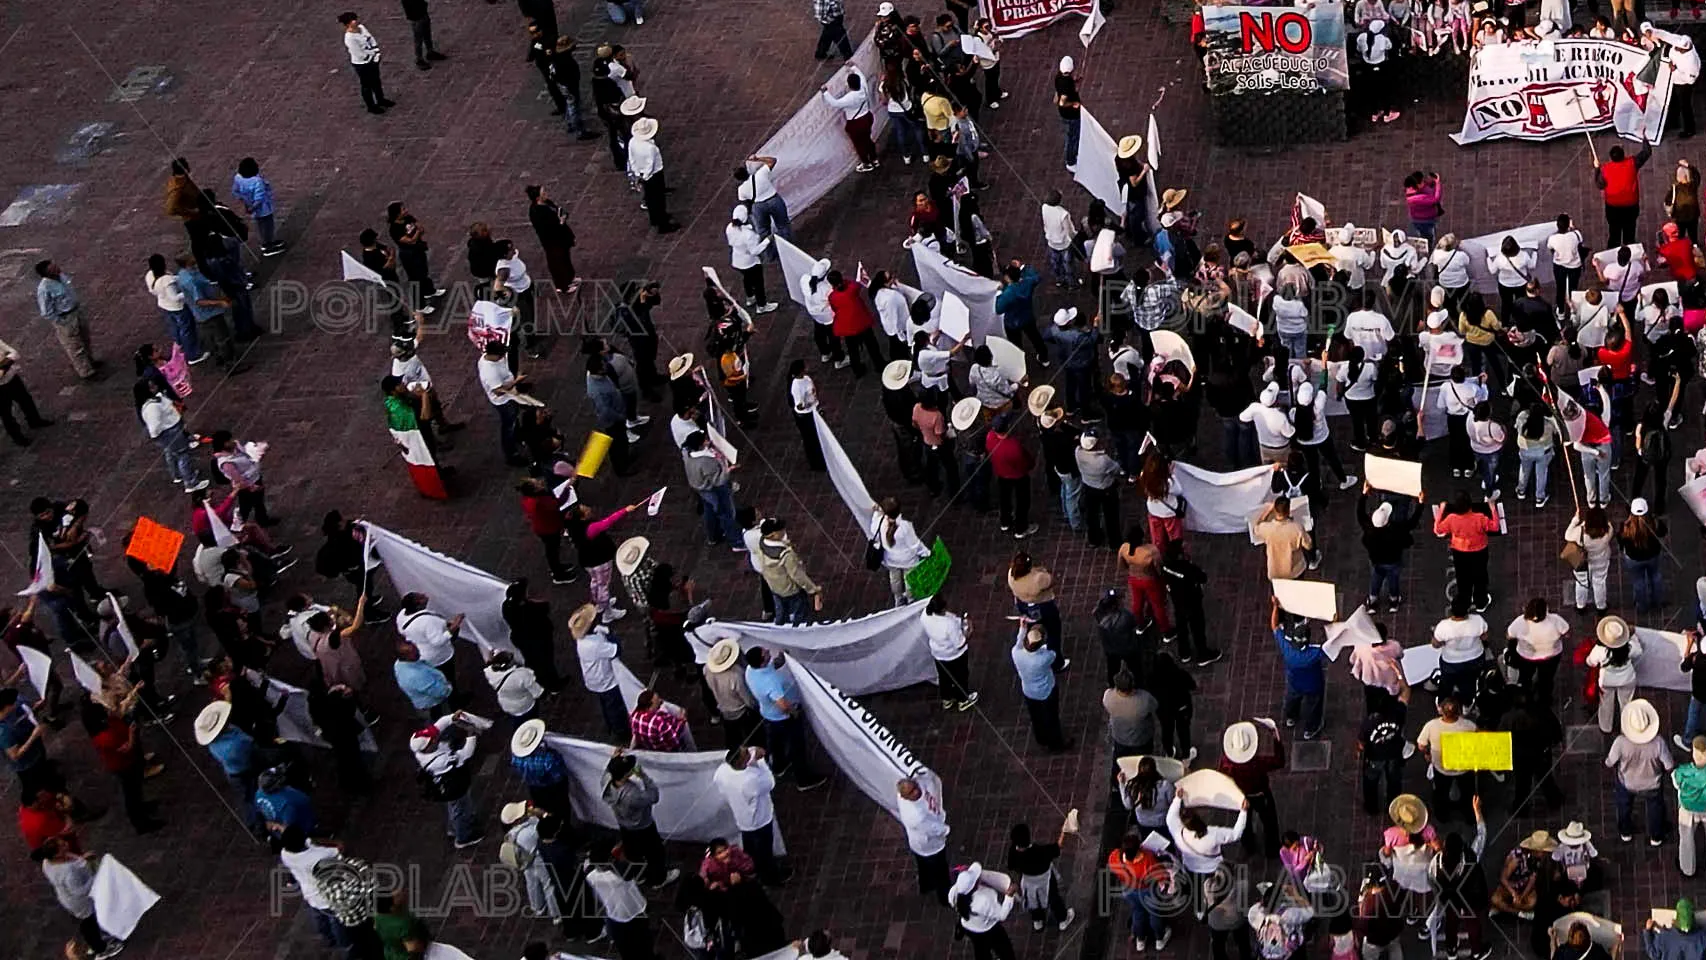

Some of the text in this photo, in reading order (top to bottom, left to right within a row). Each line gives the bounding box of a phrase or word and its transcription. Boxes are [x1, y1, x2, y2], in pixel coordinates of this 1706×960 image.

[1002, 2, 1047, 22] PRESA
[1239, 11, 1312, 54] NO
[1220, 56, 1328, 73] AL ACUEDUCTO
[1571, 47, 1623, 66] RIEGO
[1235, 72, 1319, 90] Solis-León
[1476, 97, 1523, 124] NO
